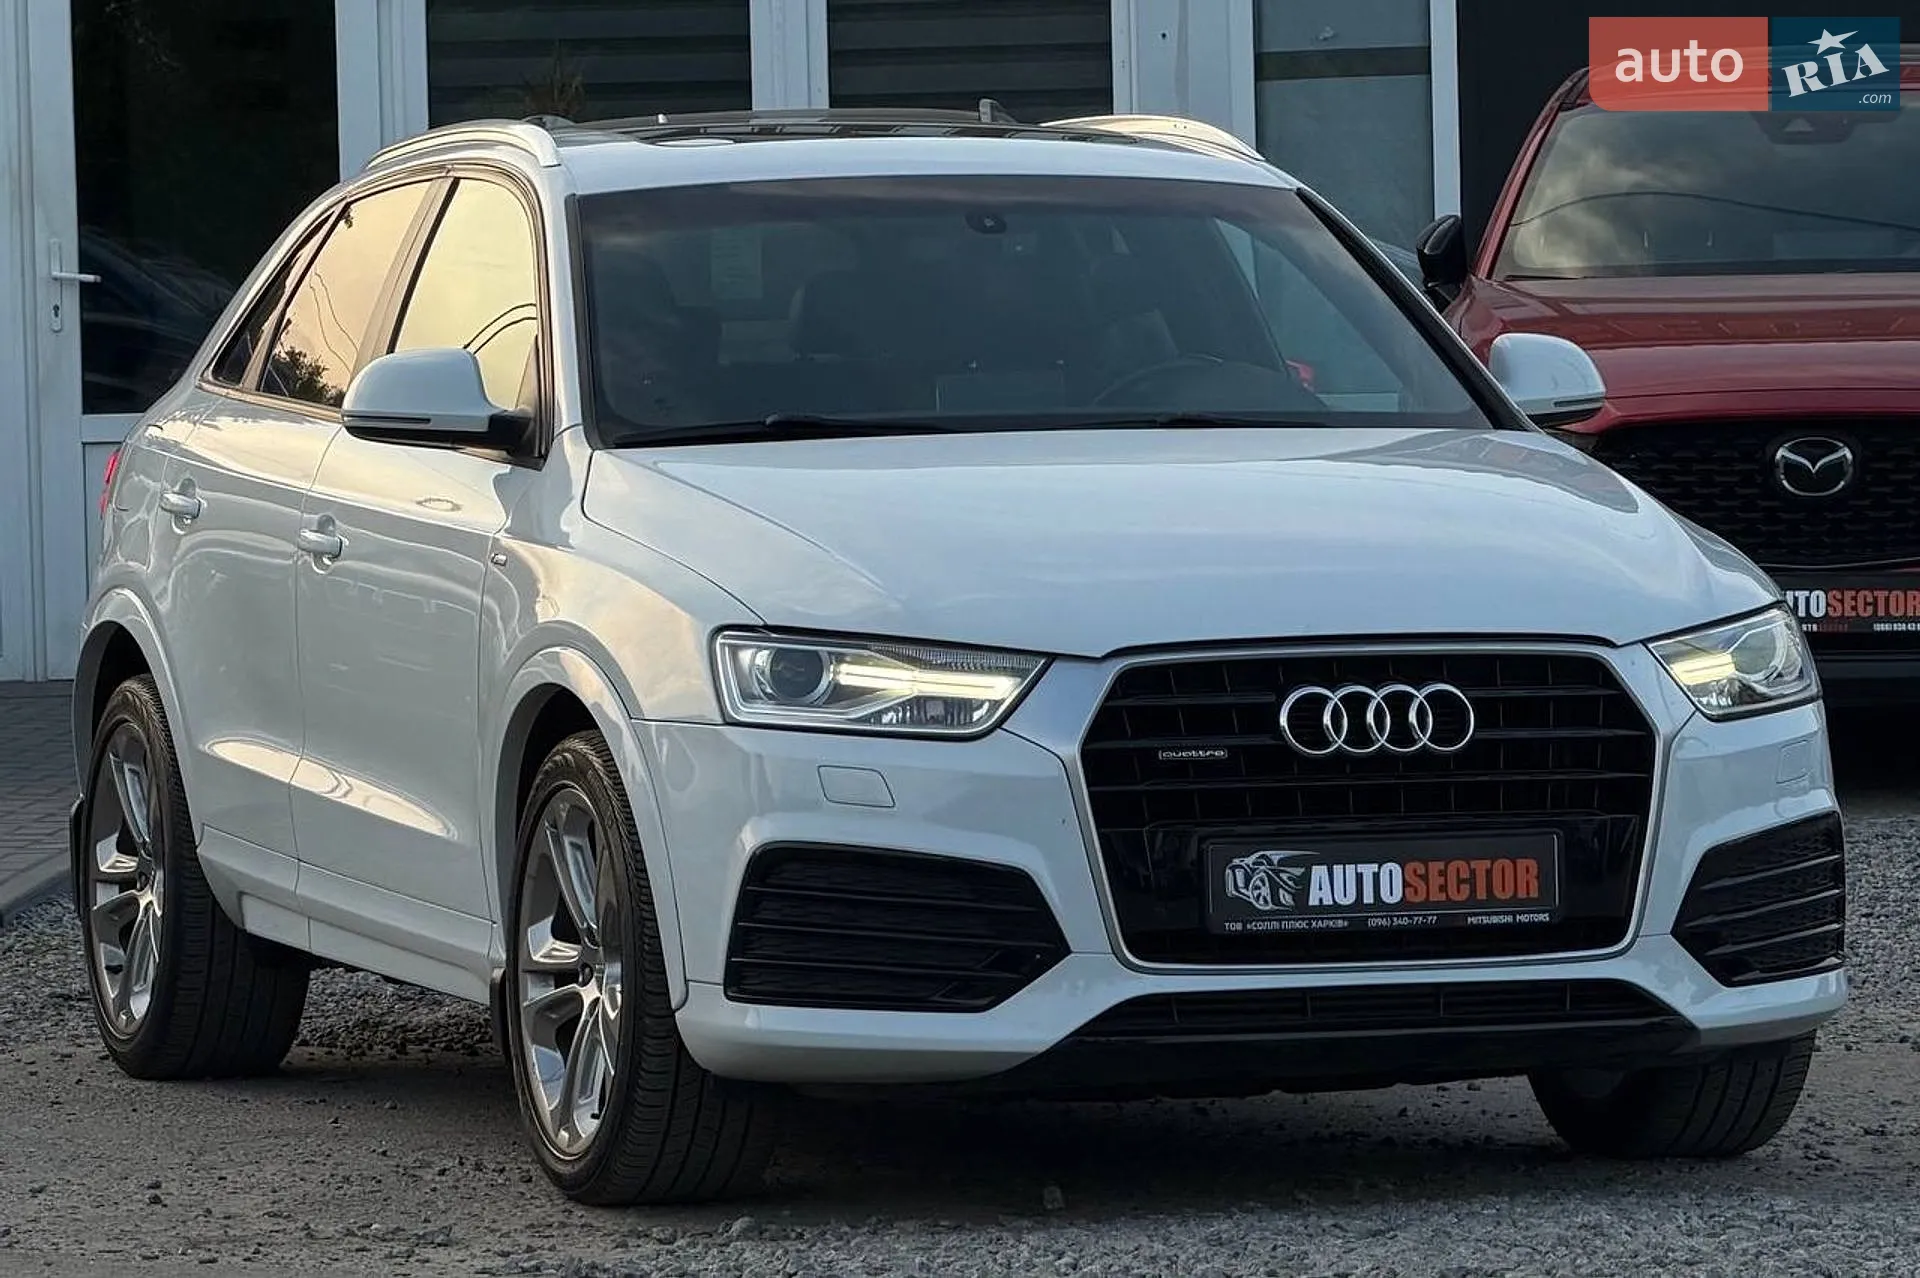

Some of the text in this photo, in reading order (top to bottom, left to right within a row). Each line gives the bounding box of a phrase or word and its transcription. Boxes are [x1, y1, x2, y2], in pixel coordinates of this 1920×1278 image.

[1308, 858, 1539, 907] AUTOSECTOR
[1467, 913, 1550, 925] MITSUBISHI MOTORS
